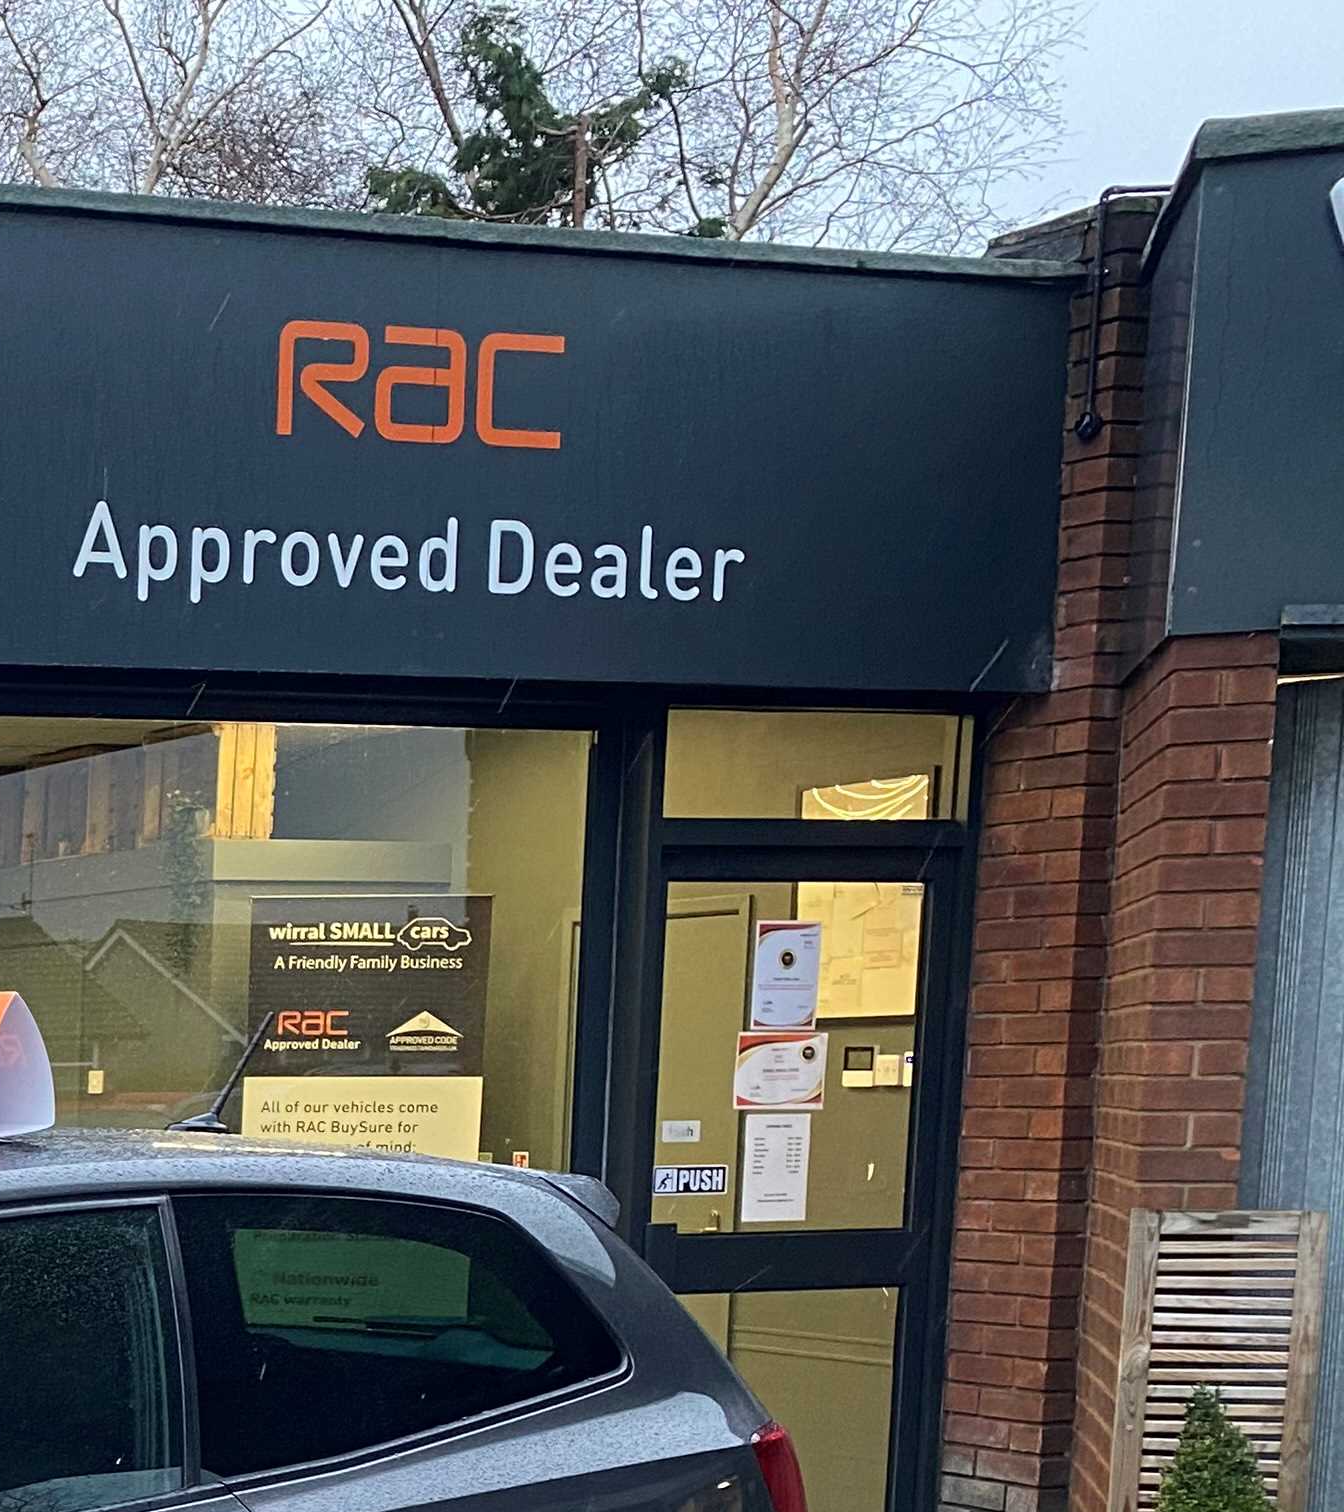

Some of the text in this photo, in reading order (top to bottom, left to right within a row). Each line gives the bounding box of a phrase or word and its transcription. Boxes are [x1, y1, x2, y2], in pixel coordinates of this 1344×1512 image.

[72, 500, 745, 603] Approved Dealer
[269, 922, 450, 940] wirral SMALL cars
[273, 955, 463, 972] A Friendly Family Business
[263, 1038, 362, 1052] Approved Dealer
[261, 1100, 439, 1113] All of our vehicles come
[261, 1120, 419, 1136] with RAC BuySure for
[678, 1168, 724, 1192] PUSH
[272, 1271, 380, 1287] Nationwide
